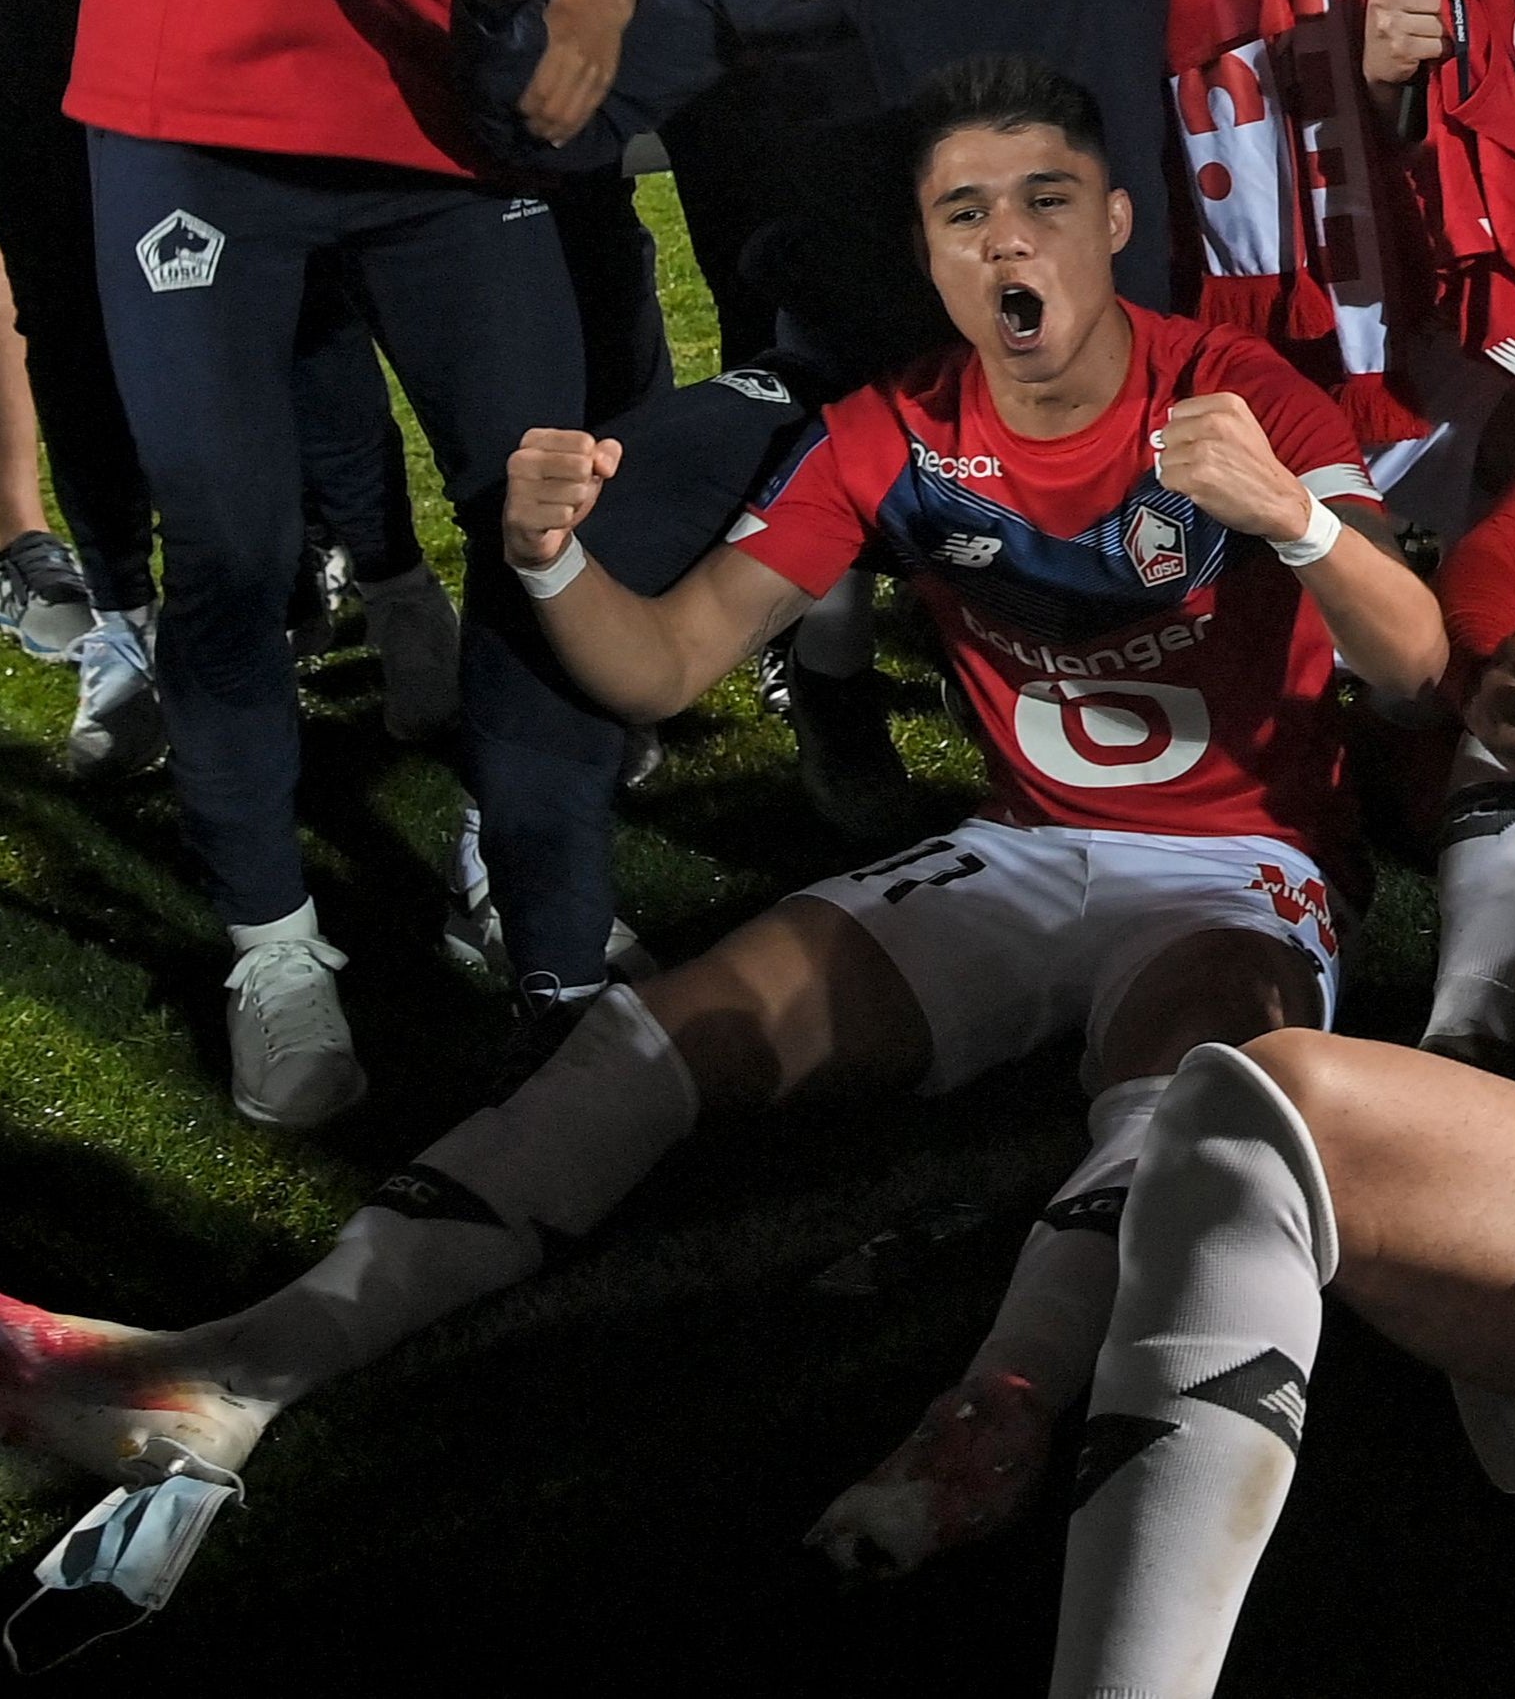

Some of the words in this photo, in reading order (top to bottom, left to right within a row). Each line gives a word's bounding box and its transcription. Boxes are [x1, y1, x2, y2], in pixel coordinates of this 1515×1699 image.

[910, 440, 1003, 480] neosat
[1145, 559, 1182, 580] LOSC
[961, 608, 1213, 676] boulanger
